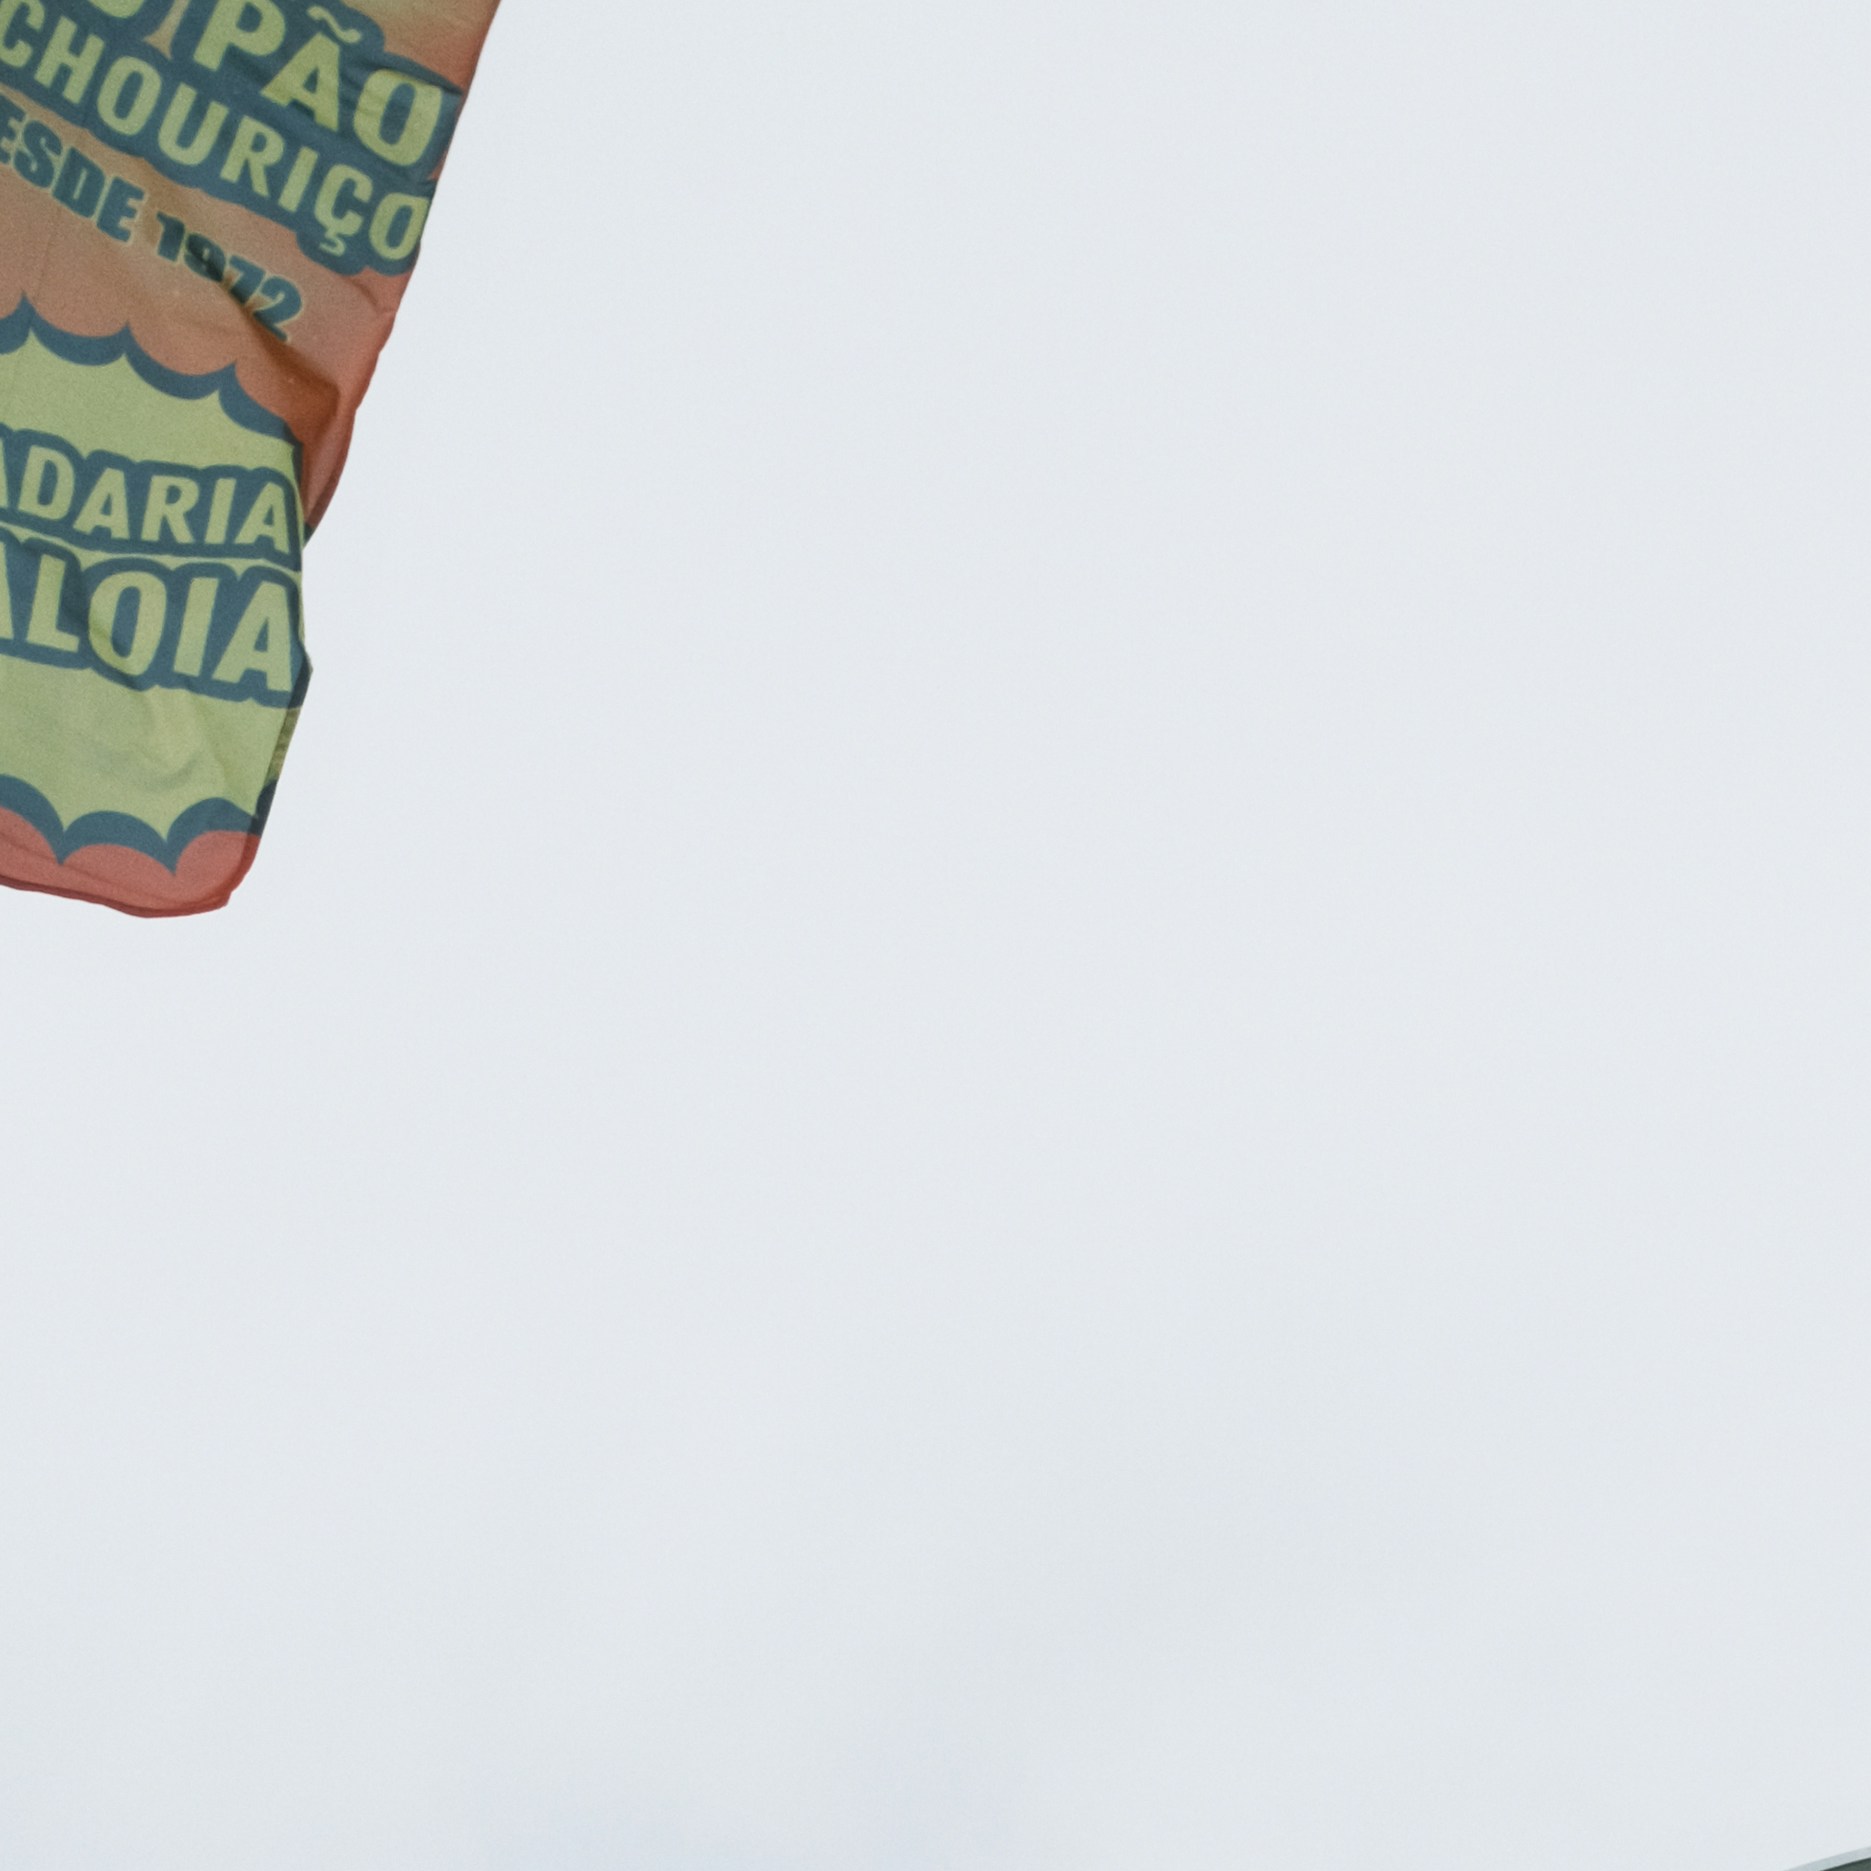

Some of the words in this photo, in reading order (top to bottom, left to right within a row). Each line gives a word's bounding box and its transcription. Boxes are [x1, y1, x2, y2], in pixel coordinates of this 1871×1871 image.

[0, 0, 430, 260] CHOURIÇO
[193, 0, 443, 166] PÃO
[155, 210, 302, 343] 1972
[0, 440, 290, 555] DARIA
[0, 541, 293, 693] LOIA
